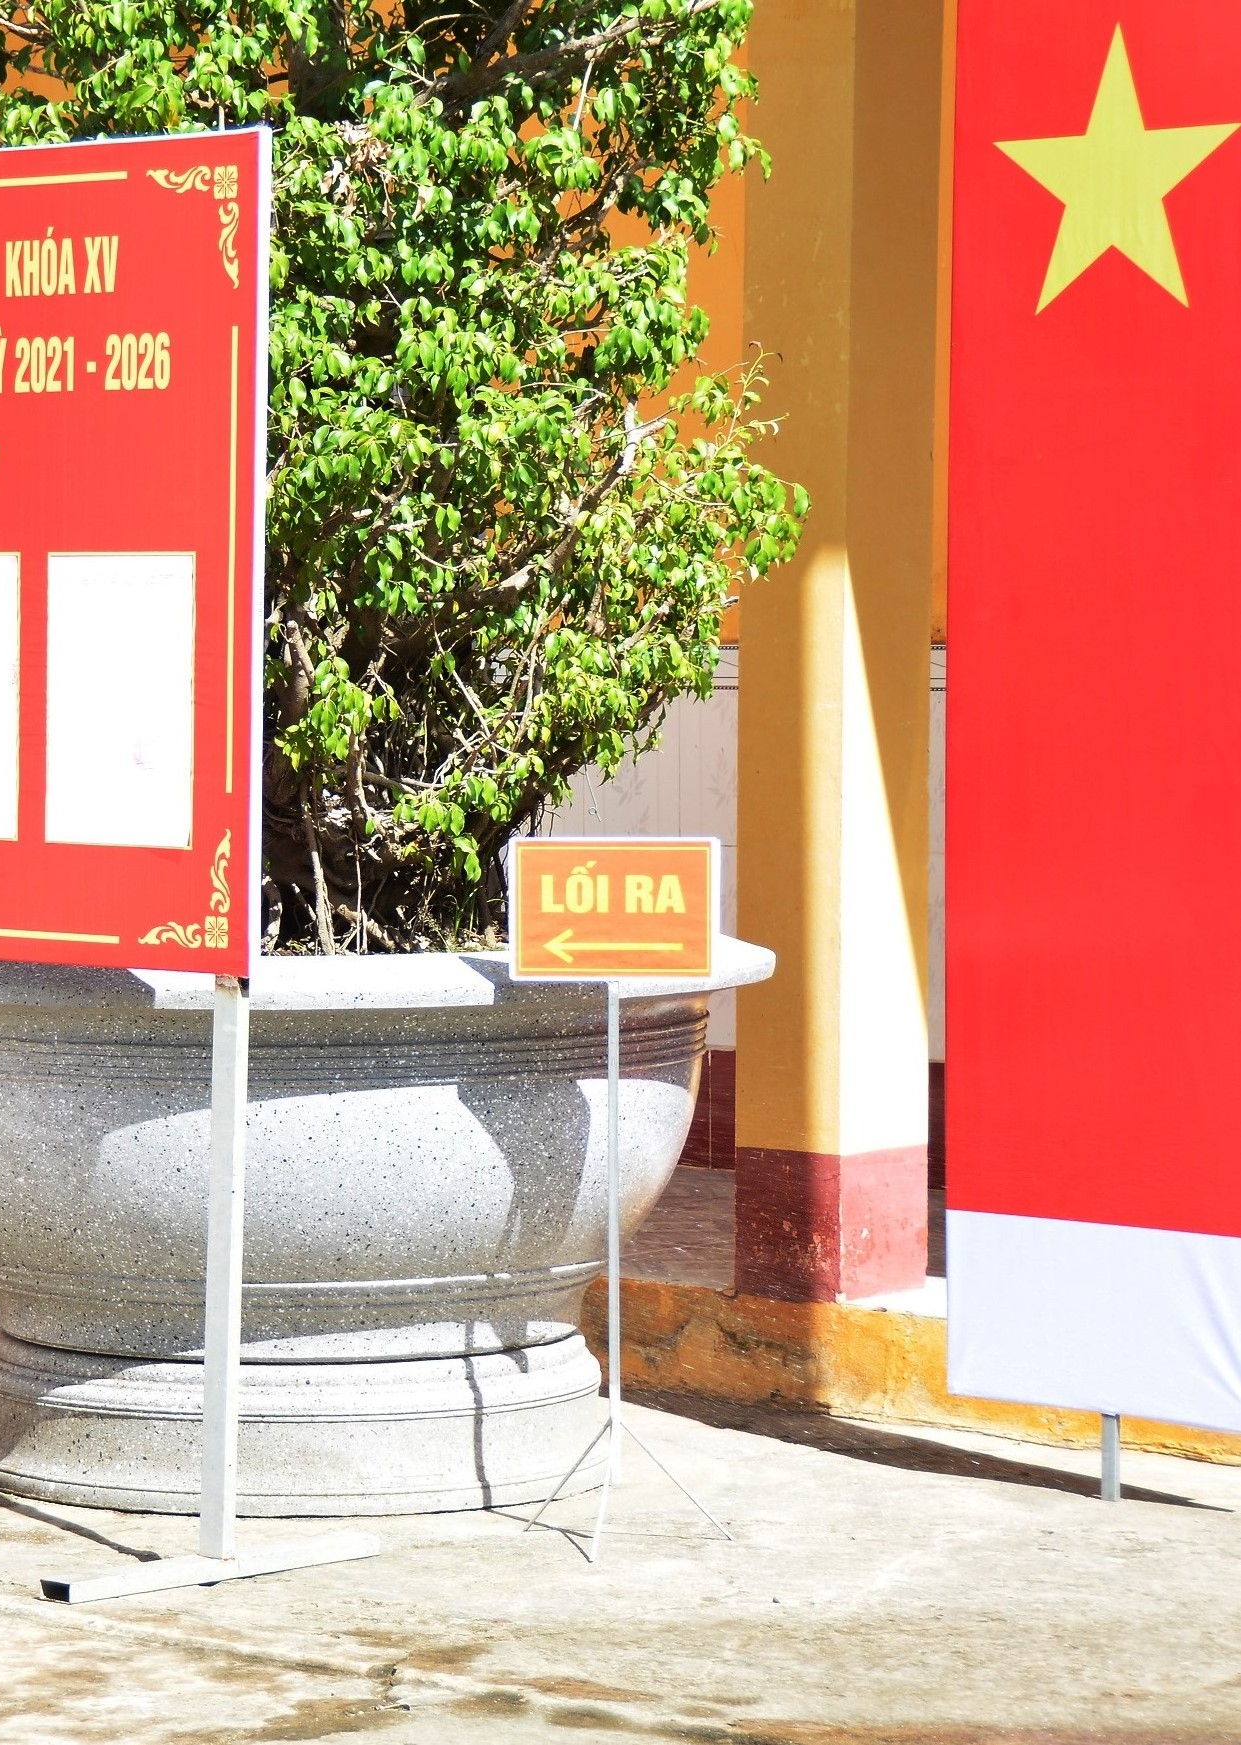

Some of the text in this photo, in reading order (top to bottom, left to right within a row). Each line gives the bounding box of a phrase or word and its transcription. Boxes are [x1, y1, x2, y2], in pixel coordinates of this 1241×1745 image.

[6, 227, 75, 297] KHÓA
[84, 236, 118, 293] XV
[15, 336, 74, 393] 2021
[105, 332, 170, 390] 2026
[540, 860, 686, 914] LỐI RA
